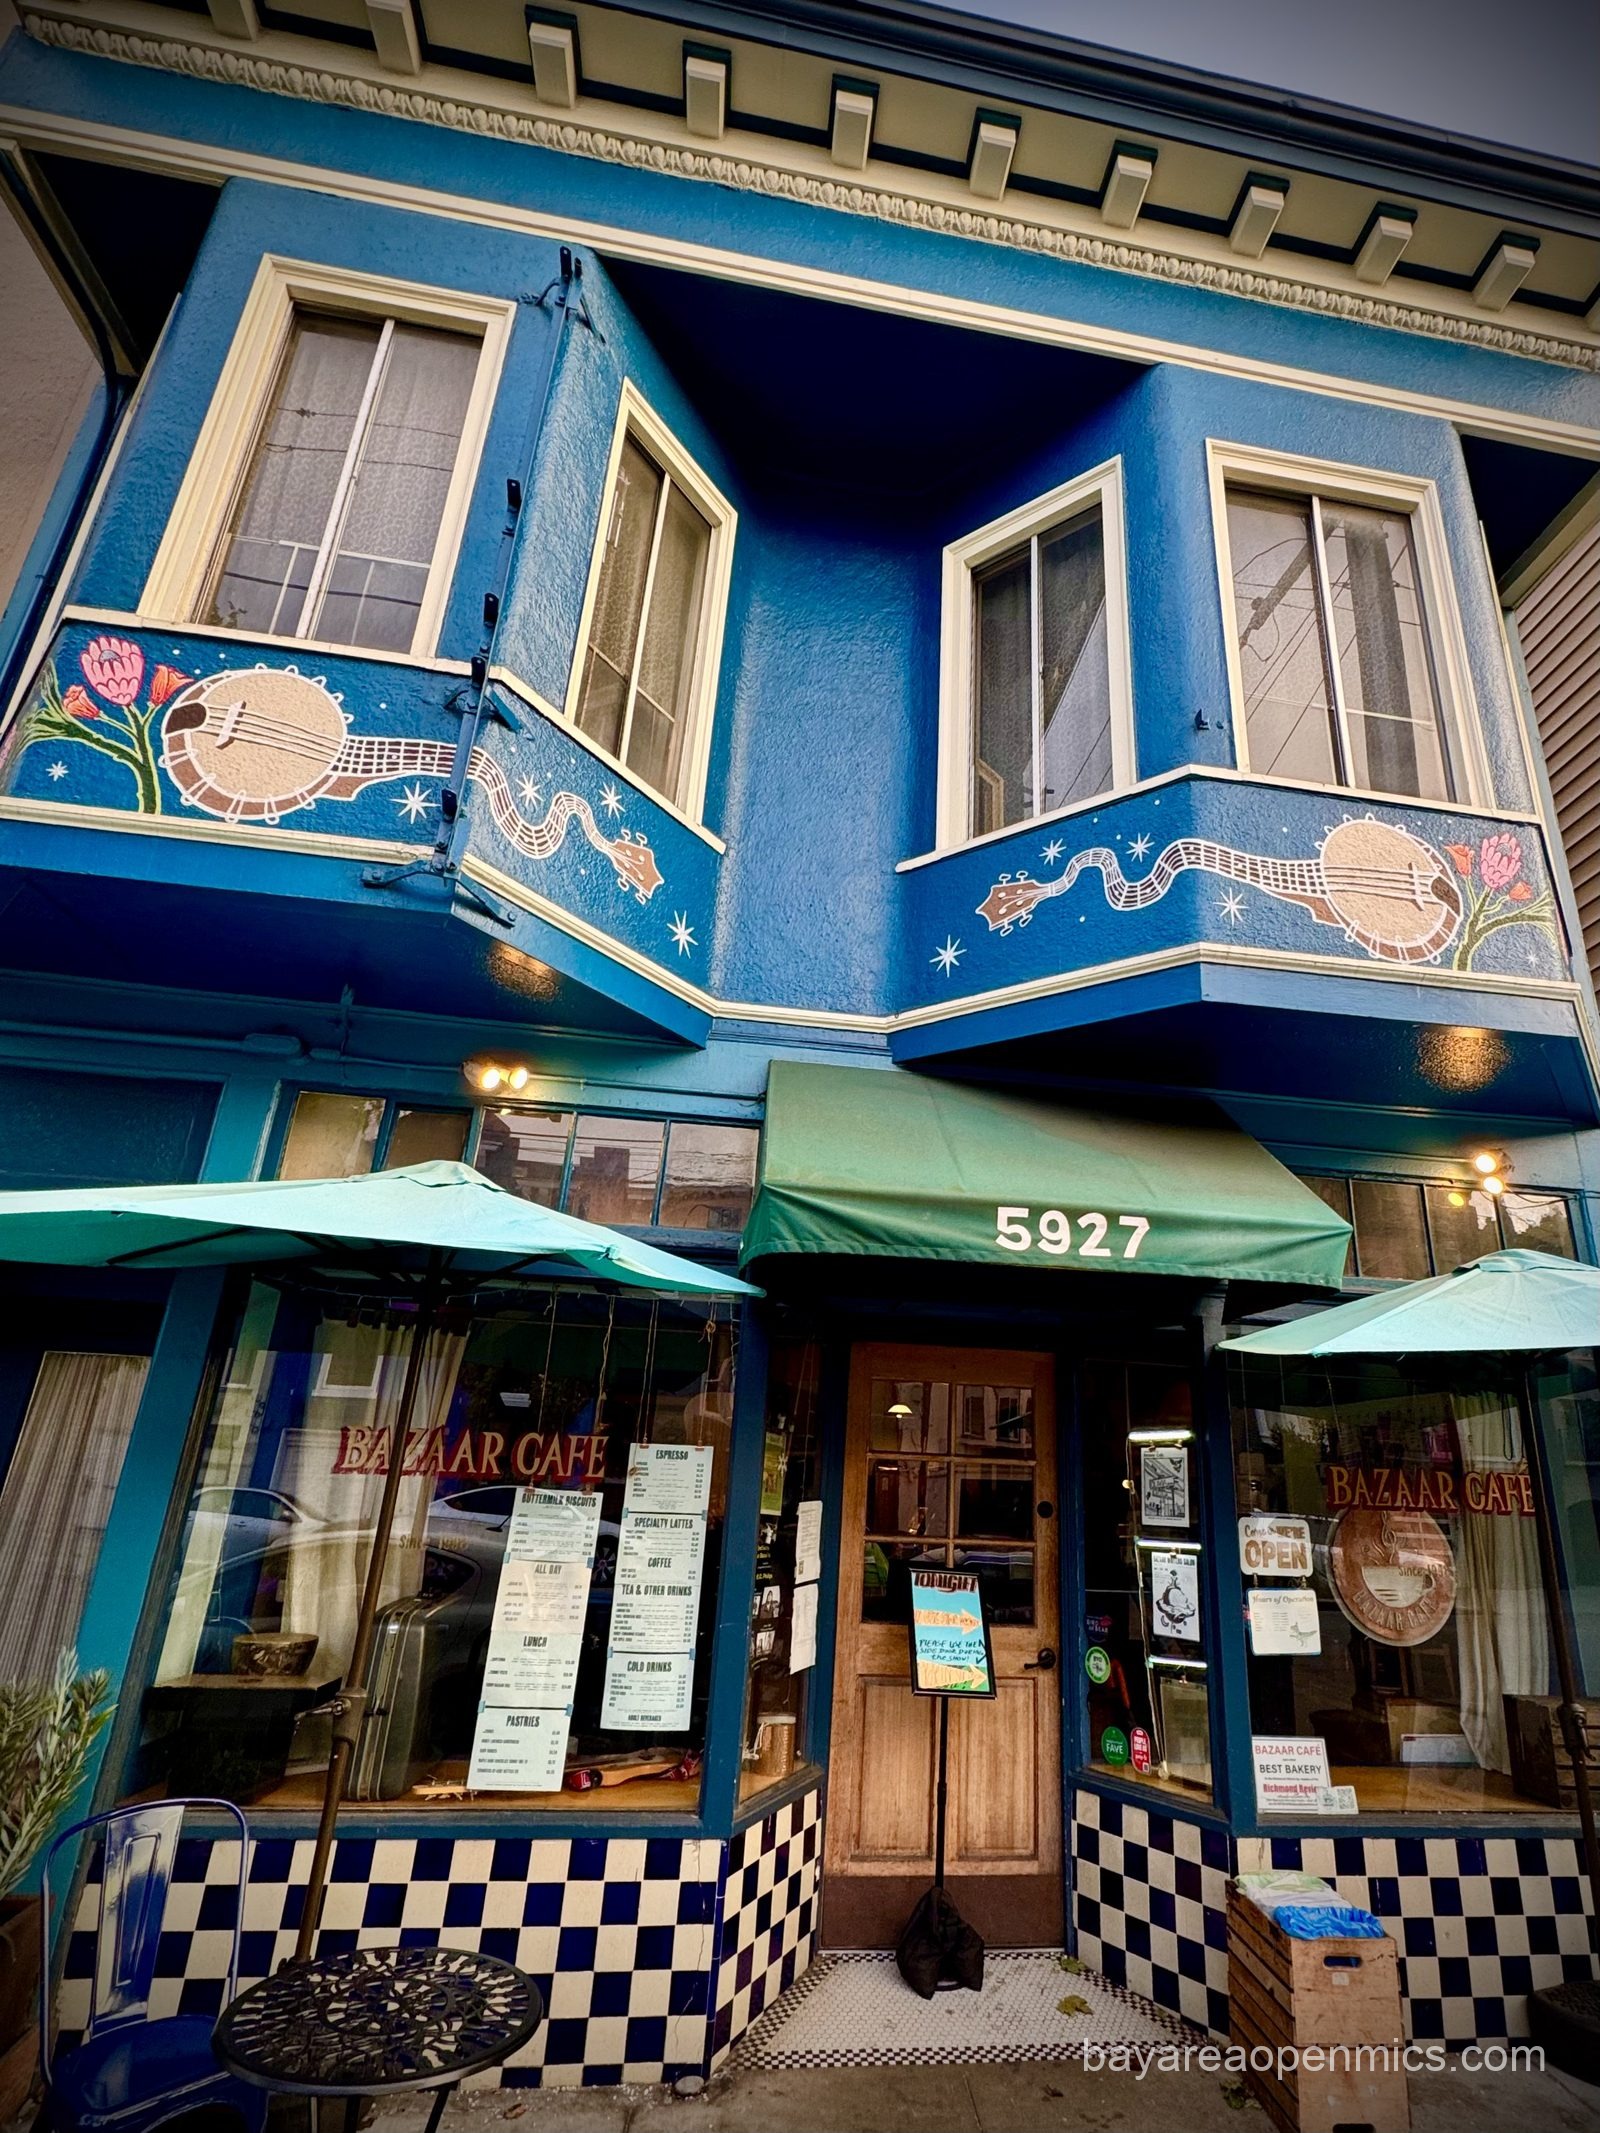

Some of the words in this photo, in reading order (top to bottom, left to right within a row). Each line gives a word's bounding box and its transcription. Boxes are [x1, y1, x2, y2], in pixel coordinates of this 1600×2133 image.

[995, 1206, 1150, 1259] 5927
[335, 1425, 505, 1475] BAZAAR
[656, 1449, 689, 1460] ESPRESSO
[1328, 1465, 1459, 1511] BAZAAR
[521, 1493, 563, 1505] BUTTERMILK
[565, 1495, 597, 1507] BISCUITS
[634, 1517, 668, 1528] SPECIALTY
[670, 1518, 694, 1529] LATTES
[1244, 1539, 1308, 1569] OPEN
[647, 1557, 672, 1568] COFFEE
[534, 1564, 547, 1574] ALL
[549, 1564, 562, 1575] DAY
[622, 1584, 634, 1595] TEA
[635, 1585, 642, 1595] &
[644, 1585, 665, 1596] OTHER
[667, 1586, 692, 1597] DRINKS
[1252, 1595, 1273, 1604] Hours
[1273, 1594, 1282, 1604] of
[1352, 1590, 1404, 1631] BAZAAR
[523, 1635, 548, 1648] LUNCH
[919, 1639, 946, 1648] PLEASE
[627, 1660, 644, 1672] COLD
[646, 1661, 673, 1673] DRINKS
[505, 1715, 540, 1728] PASTRIES
[1106, 1743, 1125, 1755] FAVE
[1254, 1745, 1295, 1756] BAZAAR
[1259, 1764, 1282, 1774] BEST
[1285, 1765, 1321, 1775] BAKERY
[1263, 1783, 1298, 1794] Richmond
[1299, 1784, 1317, 1795] Revie
